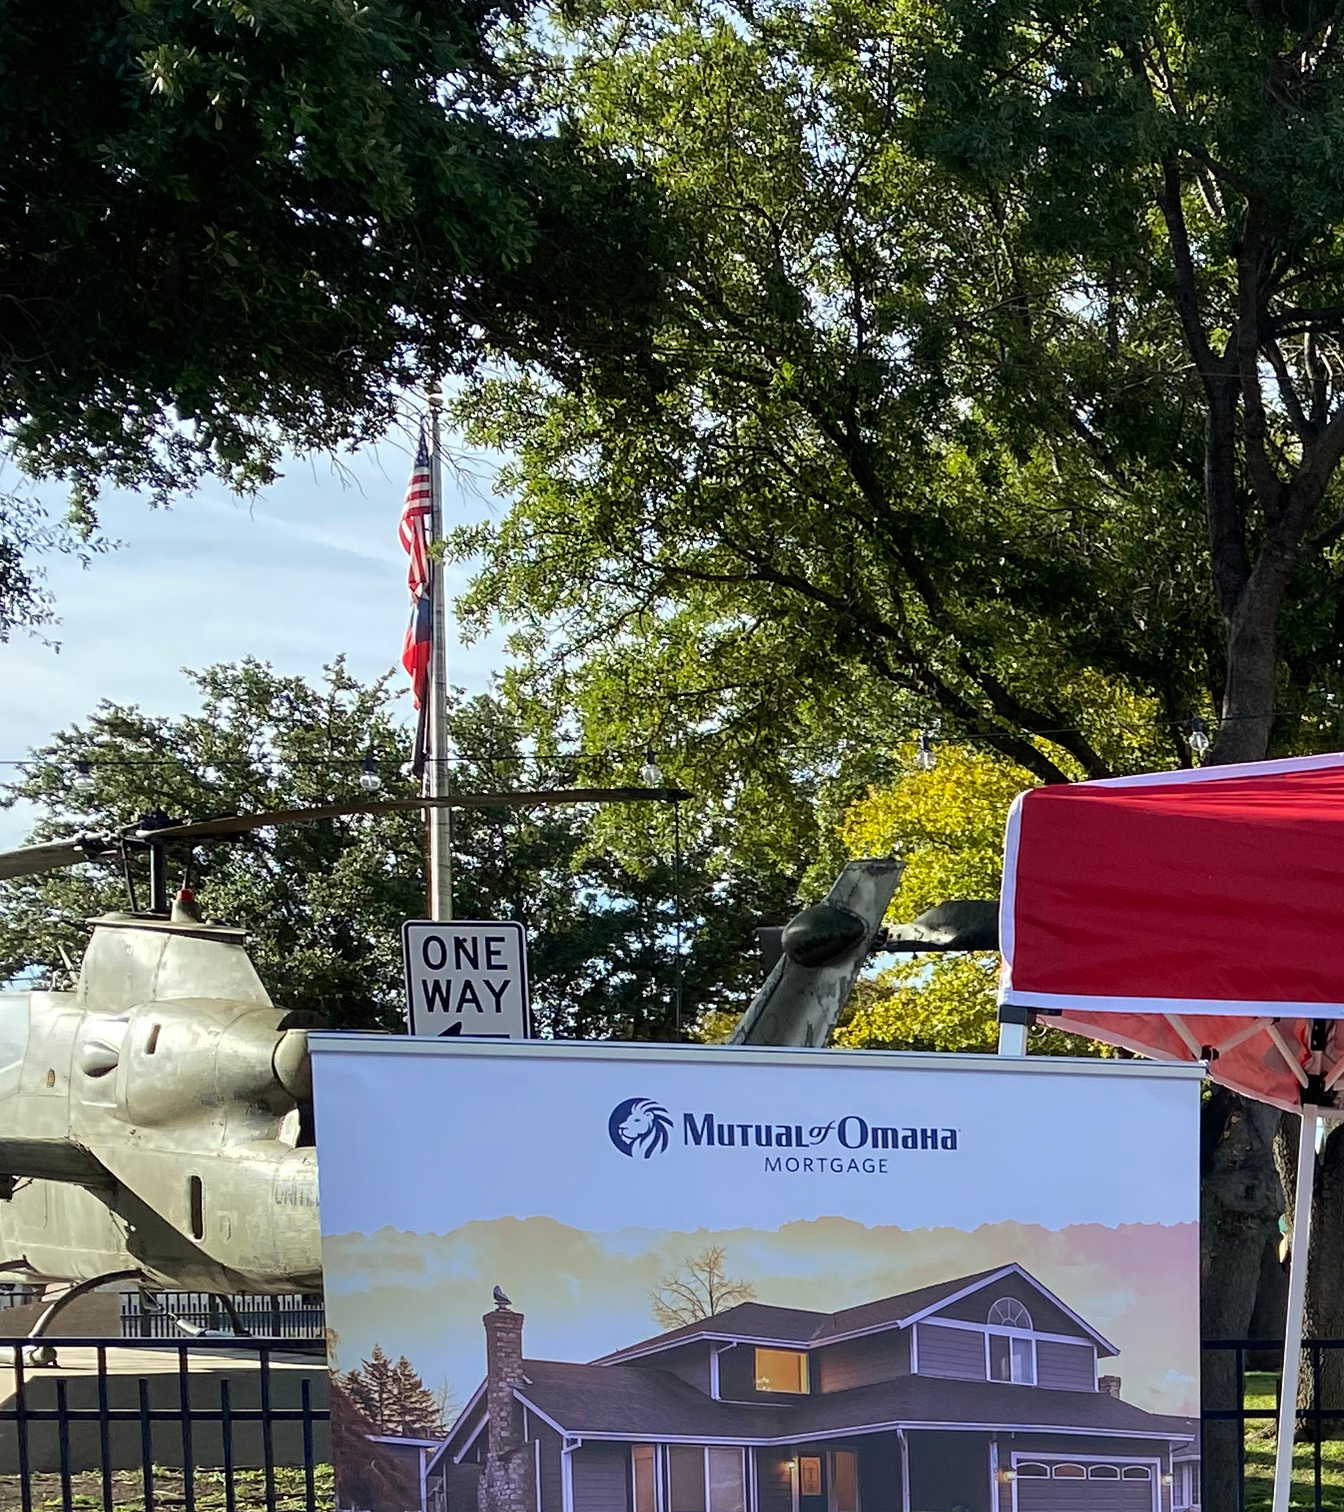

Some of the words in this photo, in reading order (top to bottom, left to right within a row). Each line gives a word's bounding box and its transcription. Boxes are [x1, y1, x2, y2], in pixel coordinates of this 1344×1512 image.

[422, 935, 508, 970] ONE
[421, 979, 511, 1013] WAY
[809, 1120, 836, 1146] of
[765, 1157, 887, 1173] MORTGAGE
